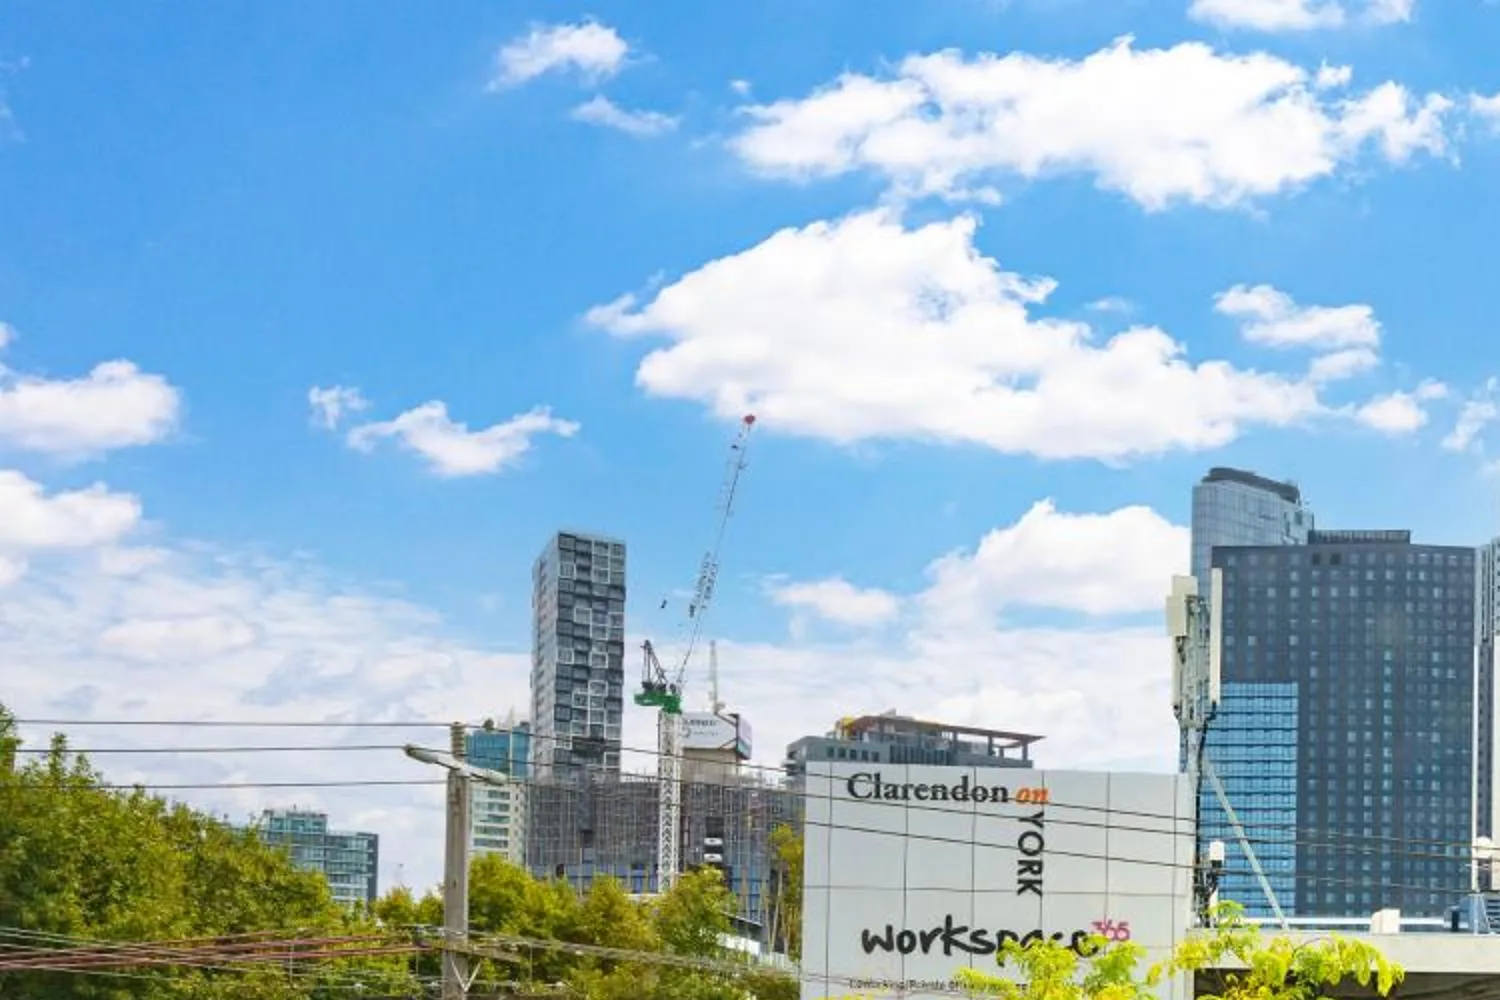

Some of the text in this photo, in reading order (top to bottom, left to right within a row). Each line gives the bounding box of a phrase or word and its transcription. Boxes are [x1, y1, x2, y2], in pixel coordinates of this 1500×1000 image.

[848, 772, 1051, 806] Clarendon on
[1017, 811, 1045, 896] YORK
[861, 914, 1100, 967] workspae
